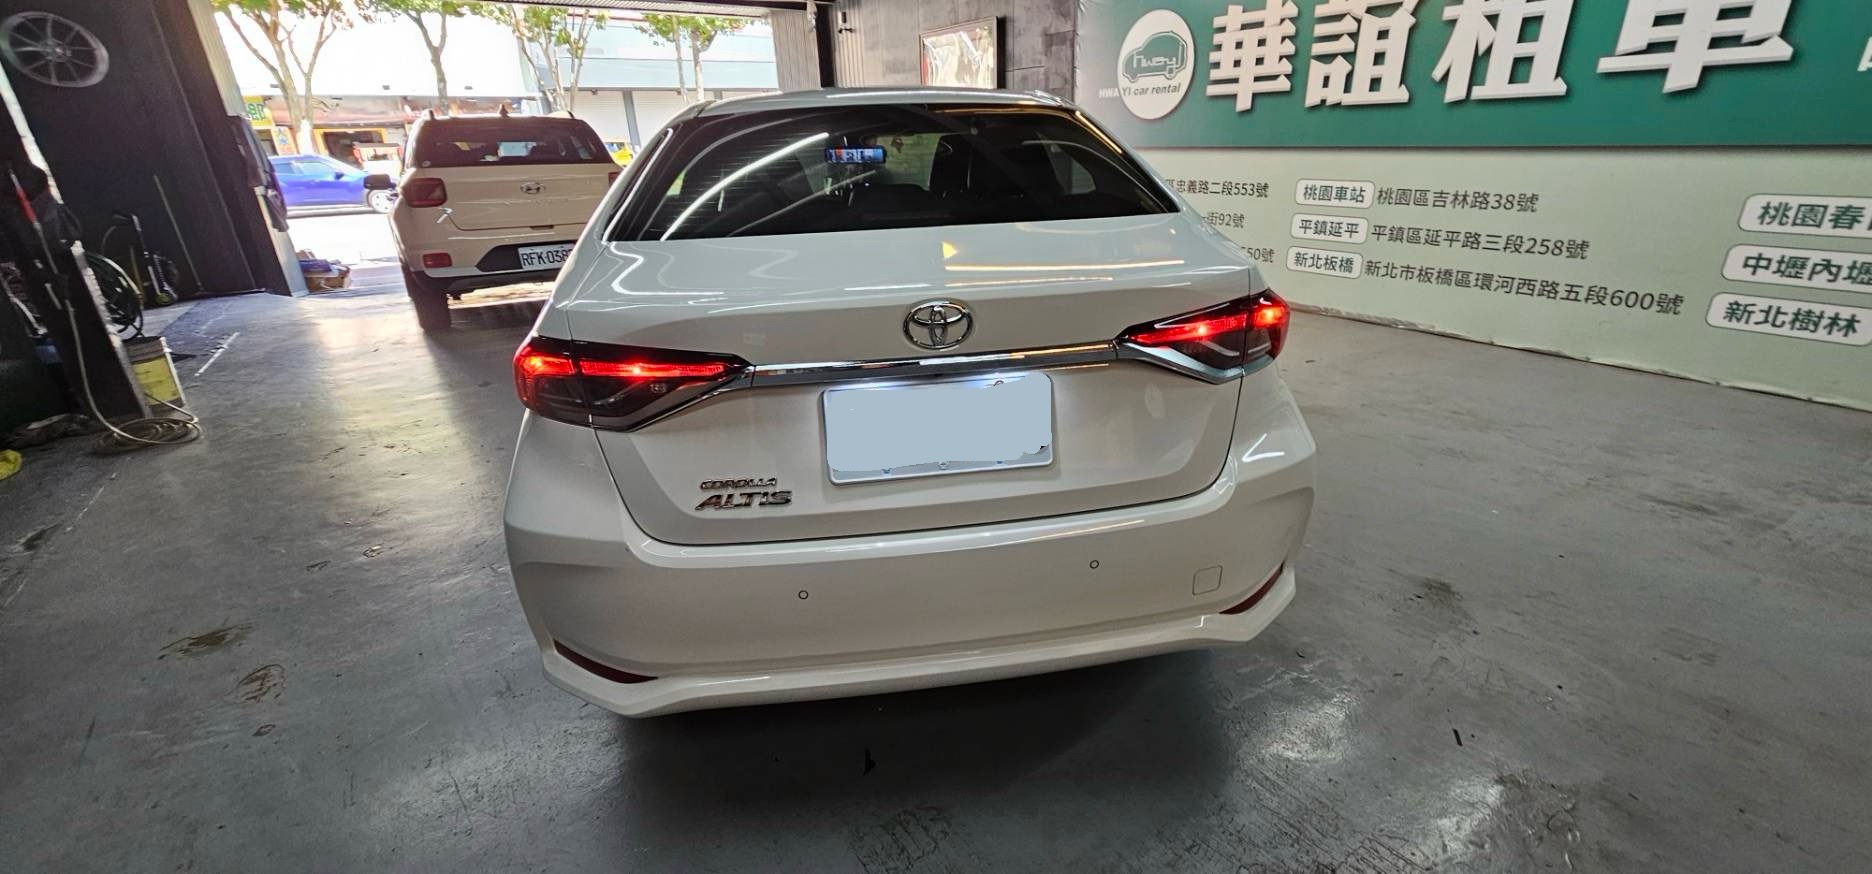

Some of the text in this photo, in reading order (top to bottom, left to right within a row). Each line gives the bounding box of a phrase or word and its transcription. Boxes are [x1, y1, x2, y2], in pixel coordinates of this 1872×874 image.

[1205, 0, 1795, 112] 華誼租車
[1098, 87, 1120, 99] HWA
[1133, 86, 1150, 96] car
[1151, 82, 1182, 95] rental
[1303, 184, 1366, 203] 桃園車站
[1377, 187, 1540, 213] 桃園區吉林路38號
[1757, 201, 1872, 231] 桃園春
[1299, 219, 1360, 239] 平鎮延平
[1371, 224, 1590, 260] 平鎮區延平路三段258號
[521, 248, 573, 267] RFK-038
[1241, 246, 1275, 263] 50號
[1294, 252, 1355, 274] 新北板橋
[1364, 260, 1685, 315] 新北市板橋區環河西路五段600號
[1722, 300, 1861, 338] 新北樹林
[700, 477, 777, 490] COROLLA
[695, 490, 792, 511] ALTIS
